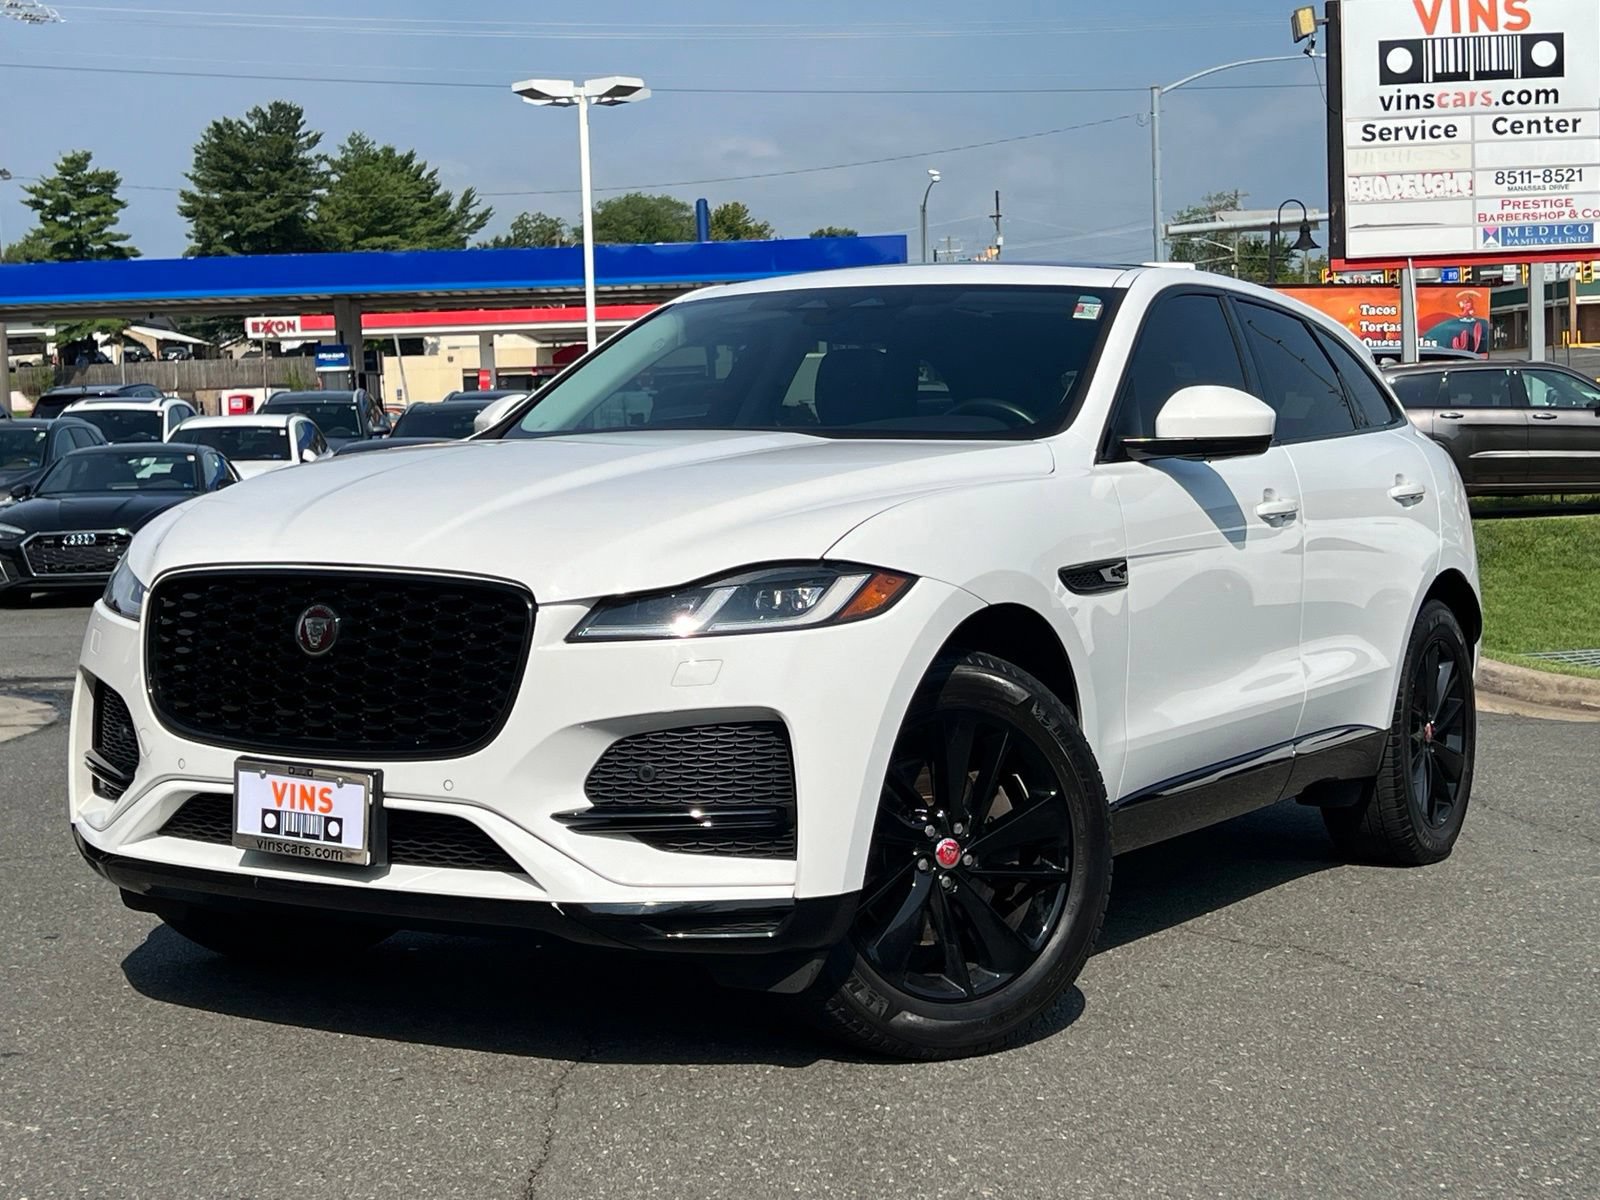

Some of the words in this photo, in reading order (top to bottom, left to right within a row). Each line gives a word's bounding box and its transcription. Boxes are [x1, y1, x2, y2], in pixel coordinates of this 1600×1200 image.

[1413, 0, 1532, 36] VINS
[1379, 88, 1560, 112] vinscars.com
[1361, 119, 1458, 142] Service
[1492, 116, 1582, 136] Center
[1494, 168, 1583, 185] 8511-8521
[1501, 198, 1574, 210] PRESTIGE
[1478, 210, 1566, 223] BARBERSHOP
[1568, 209, 1578, 219] &
[1507, 224, 1589, 237] MEDICO
[1506, 237, 1547, 246] FAMILY
[1550, 235, 1589, 244] CLINIC
[1360, 304, 1397, 316] Tacos
[251, 319, 297, 336] EXXON
[1360, 320, 1402, 333] Tortas
[271, 781, 333, 814] VINS
[256, 838, 343, 861] vinscars.com
